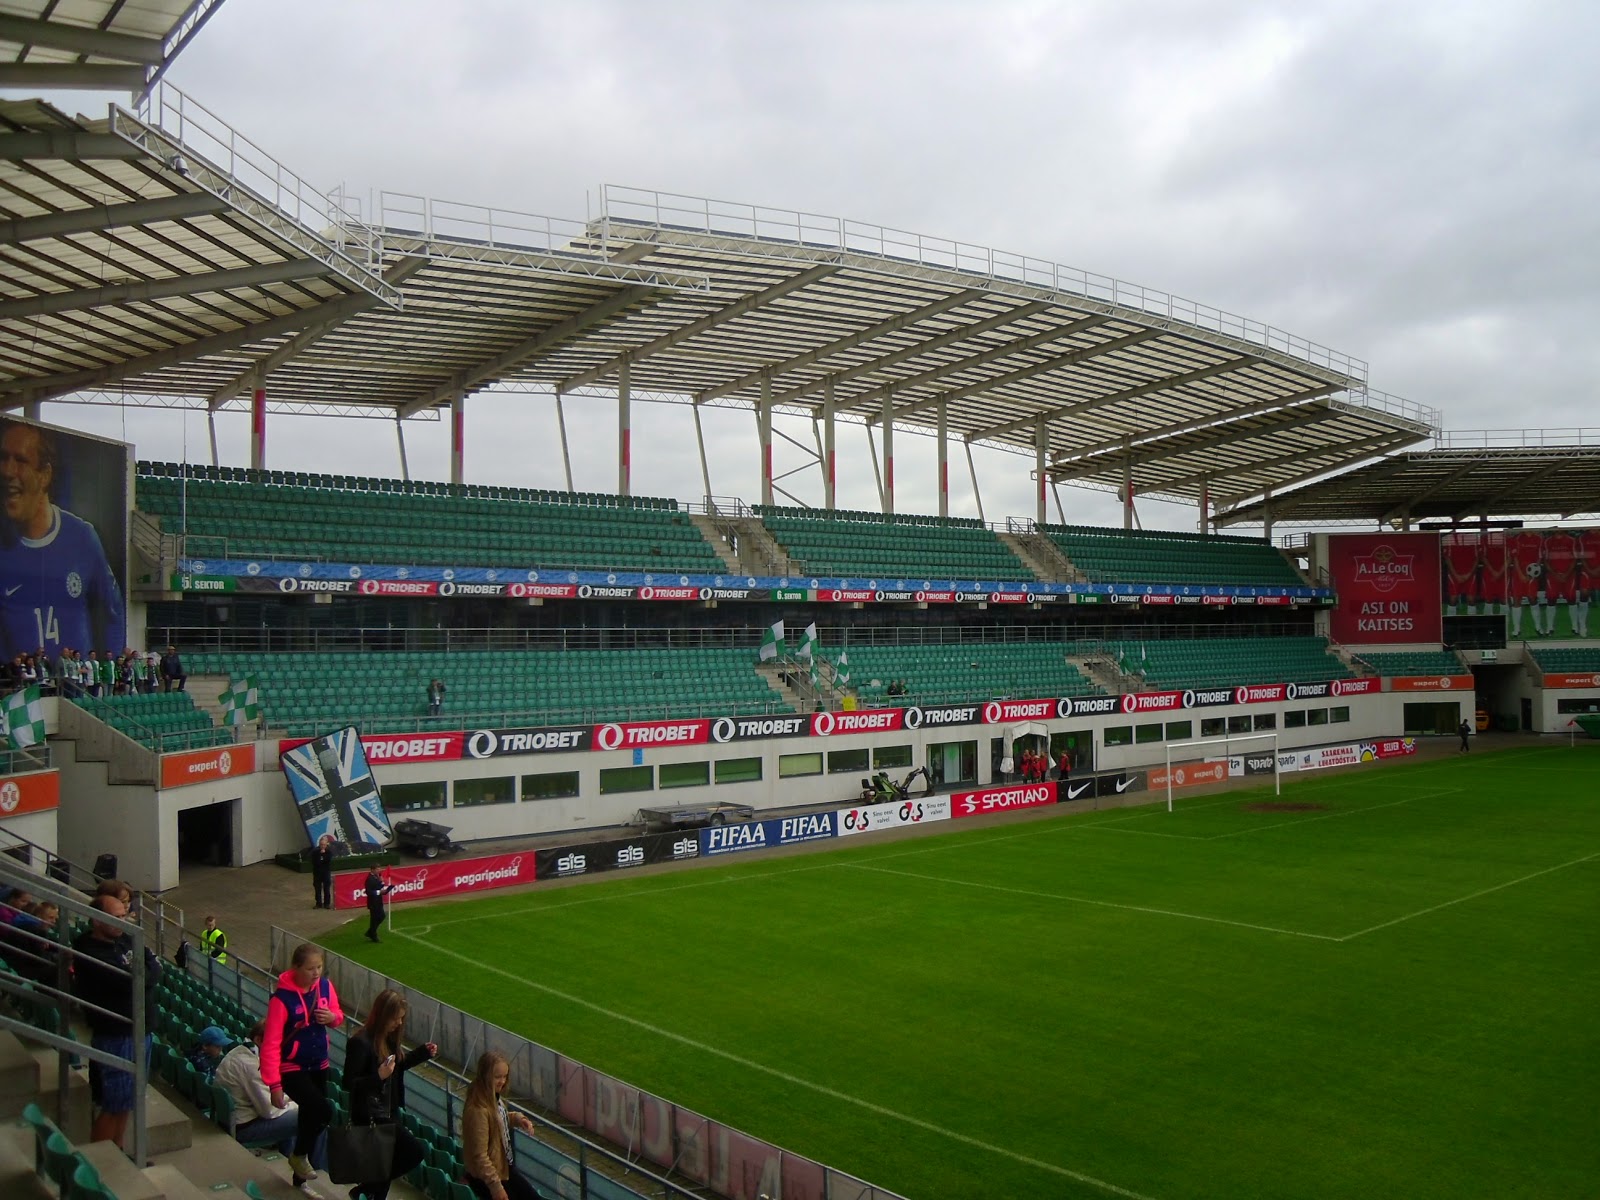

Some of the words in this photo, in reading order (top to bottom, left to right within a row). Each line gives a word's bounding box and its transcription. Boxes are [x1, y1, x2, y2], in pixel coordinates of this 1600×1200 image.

[1388, 562, 1409, 575] Coq
[195, 581, 225, 590] SEKTOR
[300, 581, 352, 592] TRIOBET
[381, 582, 430, 593] TRIOBET
[457, 584, 502, 595] TRIOBET
[527, 586, 570, 596] TRIOBET
[593, 587, 633, 597] TRIOBET
[655, 589, 693, 598] TRIOBET
[713, 589, 749, 599] TRIOBET
[842, 592, 871, 600] TRIOBET
[1119, 595, 1140, 603] TRIOBET
[1361, 602, 1384, 614] ASI
[1390, 602, 1409, 614] ON
[34, 605, 60, 649] 14
[1358, 618, 1414, 631] KAITSES
[1298, 685, 1328, 696] TRIOBET
[1342, 681, 1370, 693] TRIOBET
[1196, 691, 1231, 704] TRIOBET
[1249, 688, 1282, 700] TRIOBET
[1074, 699, 1116, 713] TRIOBET
[1138, 694, 1176, 708] TRIOBET
[925, 708, 976, 724] TRIOBET
[1004, 703, 1049, 718] TRIOBET
[738, 718, 803, 737] TRIOBET
[837, 713, 893, 730] TRIOBET
[627, 724, 700, 743] TRIOBET
[501, 731, 584, 752] TRIOBET
[362, 738, 451, 759] TRIOBET
[188, 759, 218, 774] expert
[1248, 757, 1273, 770] sparta
[1278, 755, 1295, 767] sparta
[1194, 770, 1214, 778] expert
[982, 787, 1049, 809] SPORTLAND
[899, 802, 923, 821] G4S
[780, 813, 832, 838] FIFAA
[844, 810, 869, 830] G4S
[709, 822, 766, 849] FIFAA
[455, 866, 519, 887] pagaripoisid
